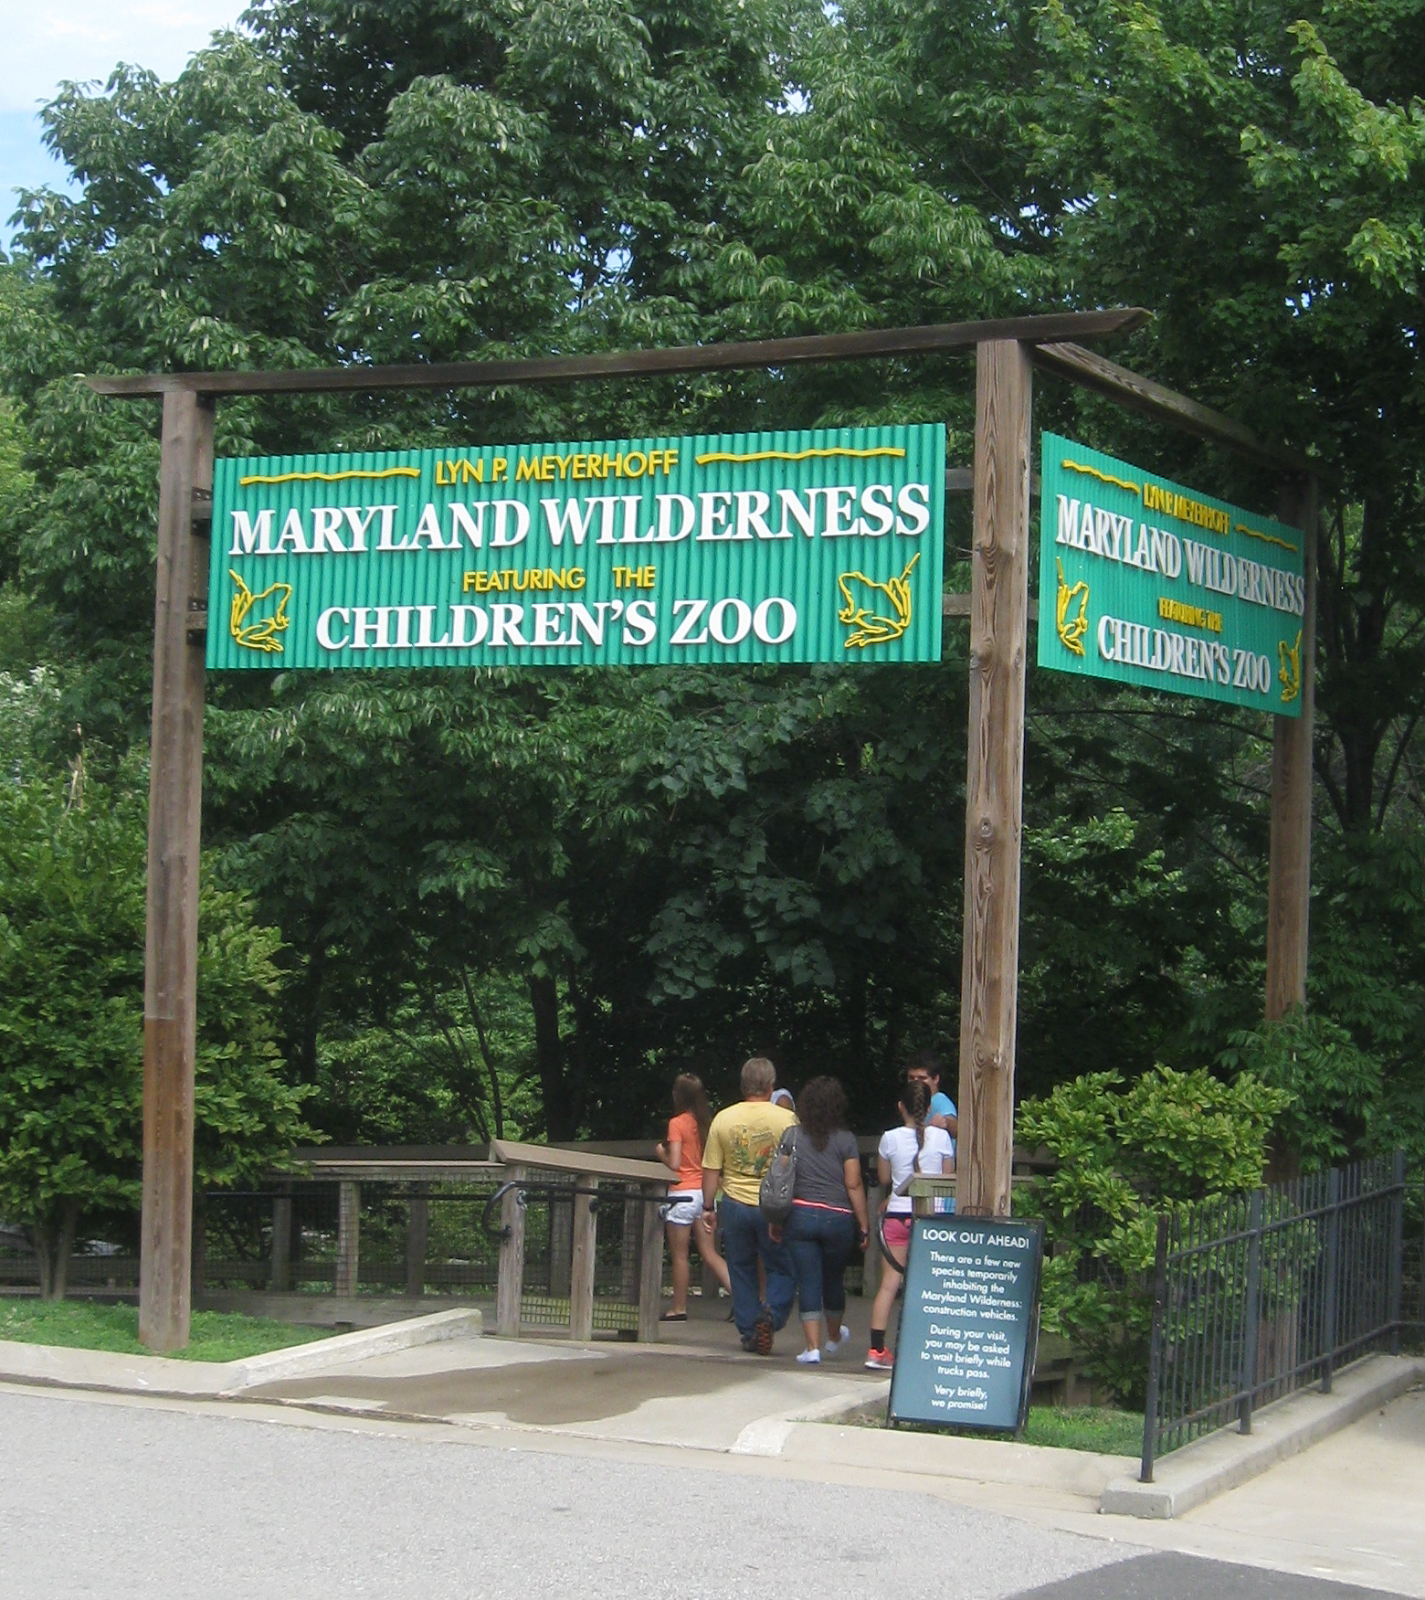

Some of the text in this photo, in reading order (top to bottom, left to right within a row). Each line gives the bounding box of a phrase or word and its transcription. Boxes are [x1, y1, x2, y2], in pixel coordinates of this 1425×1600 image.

[435, 449, 679, 485] LYN P. MEYERHOFF
[228, 483, 930, 555] MARYLAND WILDERNESS
[1056, 494, 1305, 616] MARYLAND WILDERNESS
[462, 566, 656, 592] FEATURING THE
[316, 597, 797, 650] CHILDREN'S ZOO
[1097, 615, 1271, 694] CHILDREN'S ZOO
[922, 1229, 1030, 1249] LOOK OUT AHEAD!
[930, 1250, 1021, 1269] There are a few new
[931, 1267, 1018, 1284] species temporarily
[942, 1279, 1005, 1294] inhabiting the
[921, 1289, 1023, 1308] Maryland Wilderness:
[923, 1305, 1019, 1321] construction vehicles.
[930, 1324, 1007, 1342] During your visit,
[925, 1339, 1010, 1355] you may be asked
[921, 1351, 1012, 1368] to wait briefly while
[937, 1365, 990, 1379] trucks pass.
[934, 1384, 988, 1401] Very briefly,
[931, 1399, 988, 1411] we promise!
